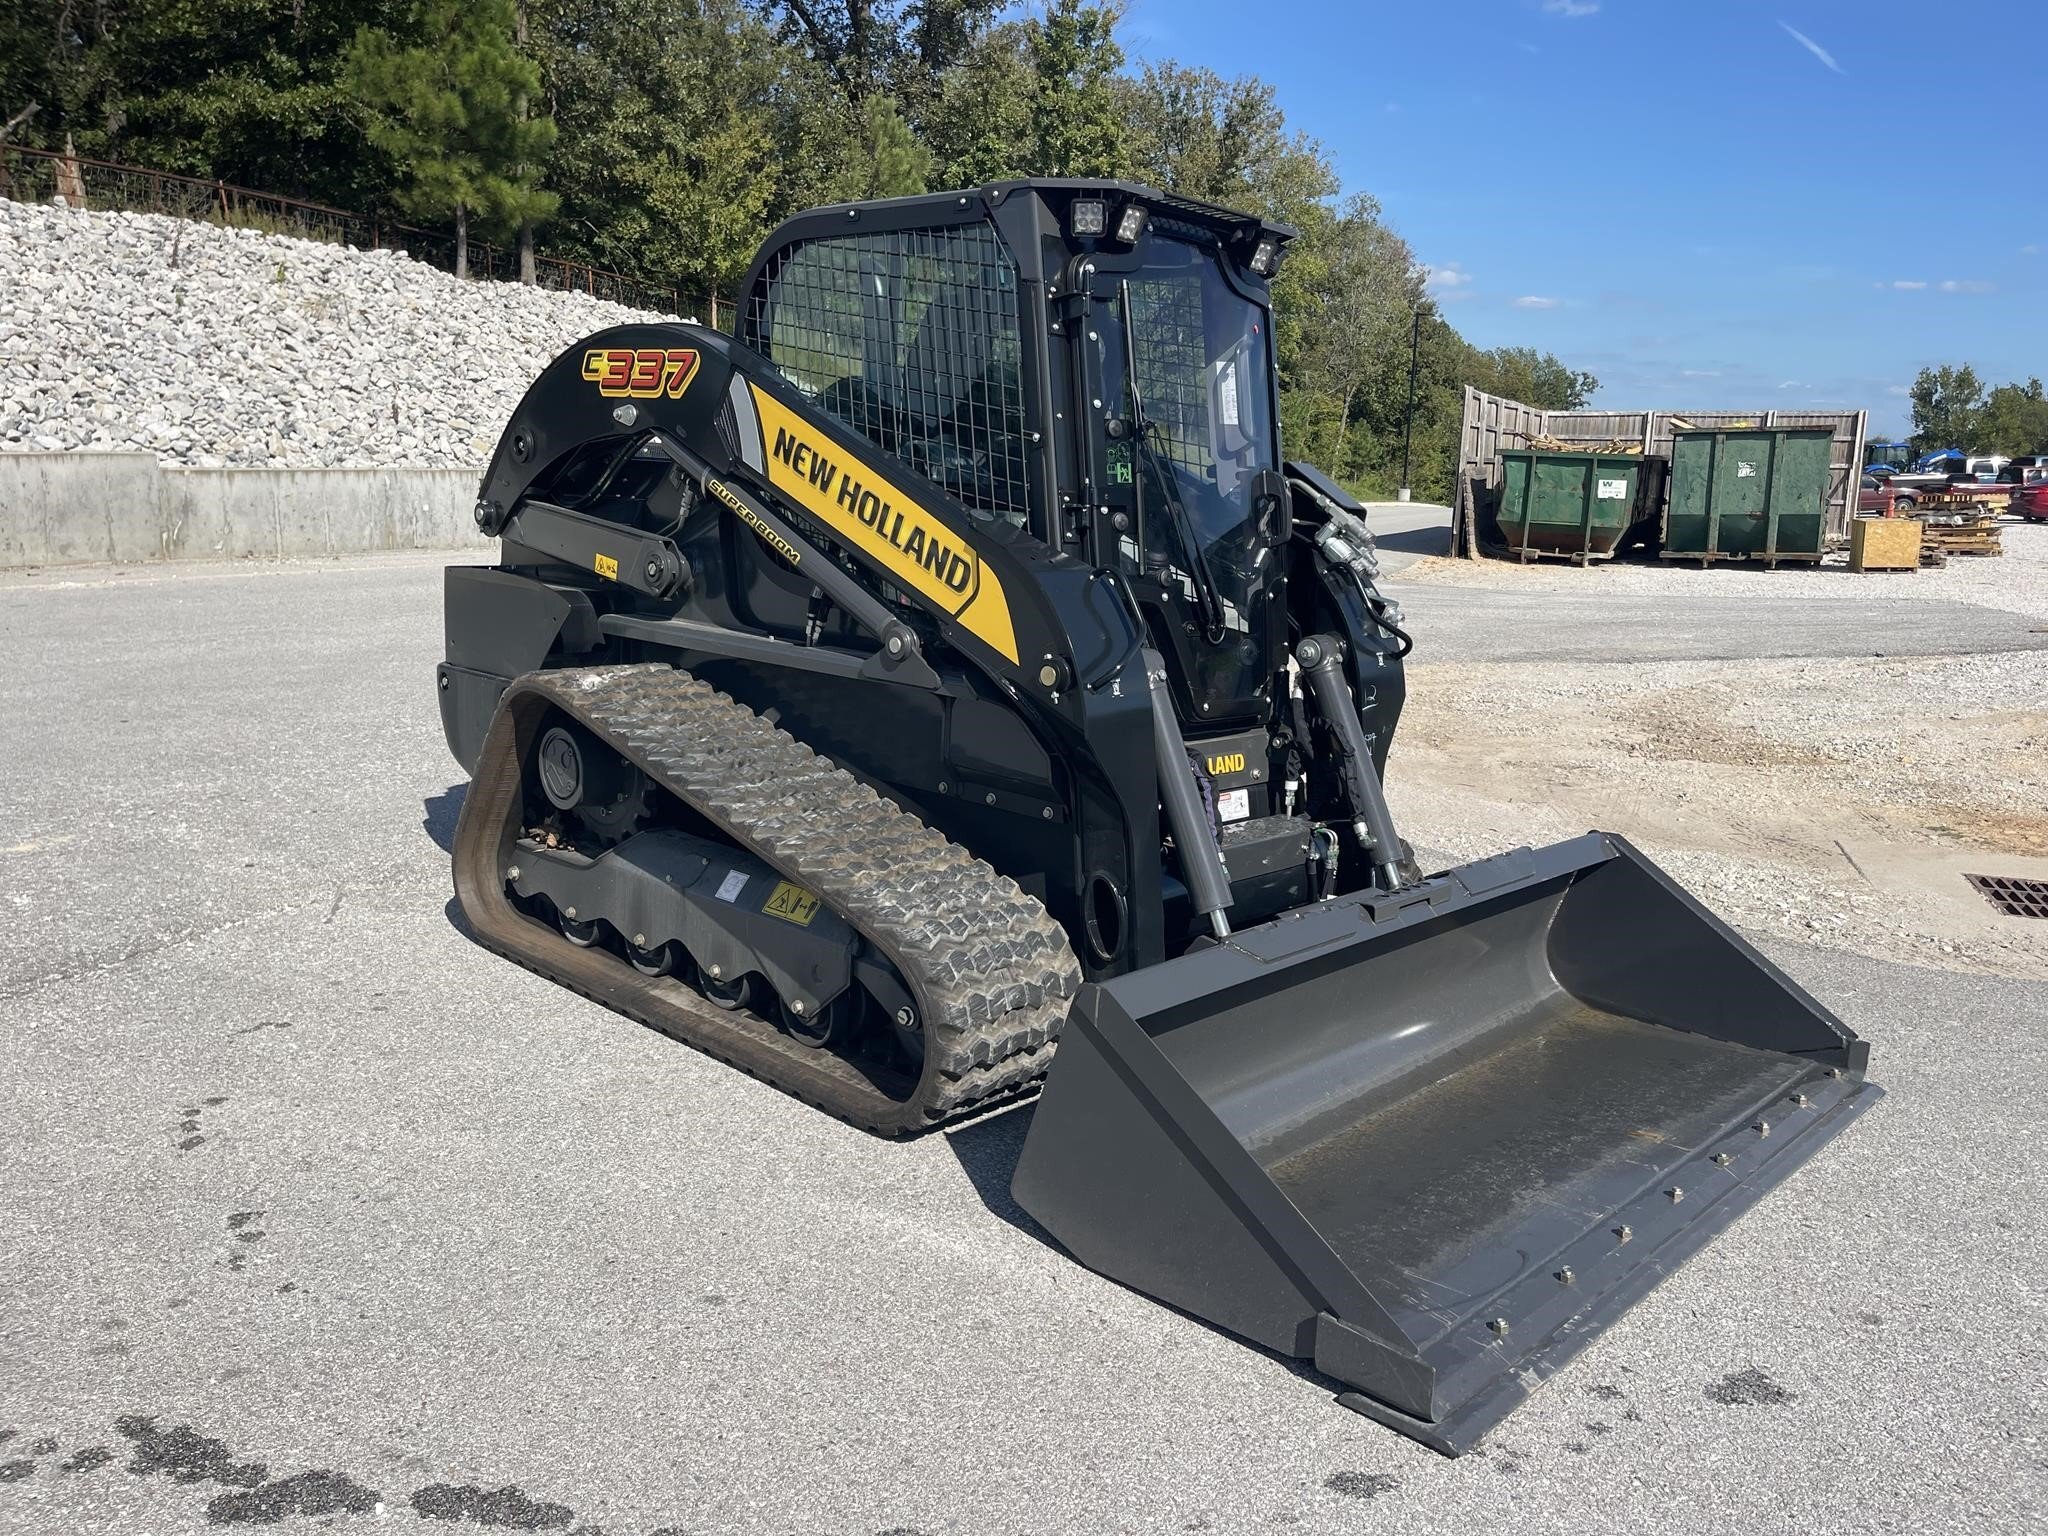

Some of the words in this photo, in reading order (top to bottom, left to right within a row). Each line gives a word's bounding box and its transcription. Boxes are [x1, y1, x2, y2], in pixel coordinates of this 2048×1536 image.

[582, 349, 700, 399] C337
[708, 480, 757, 528] SUPER
[755, 520, 800, 566] BOOM
[773, 427, 837, 493] NEW
[836, 473, 971, 594] HOLLAND
